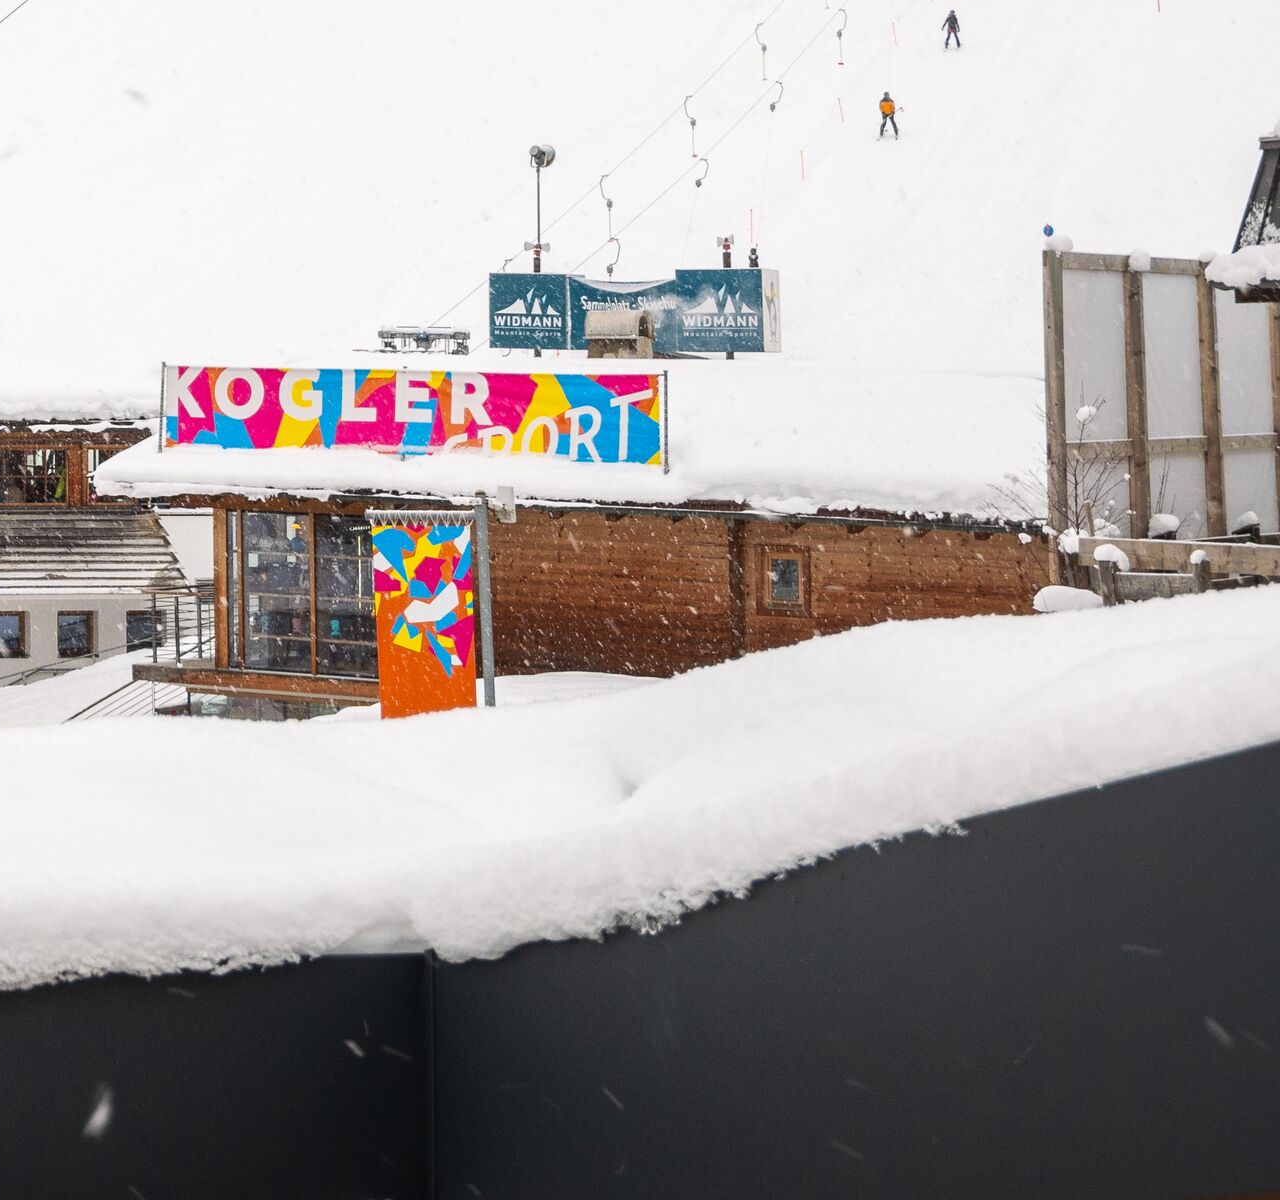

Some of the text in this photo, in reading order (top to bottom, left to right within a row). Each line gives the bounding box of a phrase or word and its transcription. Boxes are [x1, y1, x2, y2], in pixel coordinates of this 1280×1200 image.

[493, 315, 562, 328] WIDMANN
[681, 315, 758, 328] WIDMANN
[168, 368, 493, 426] KOGLER
